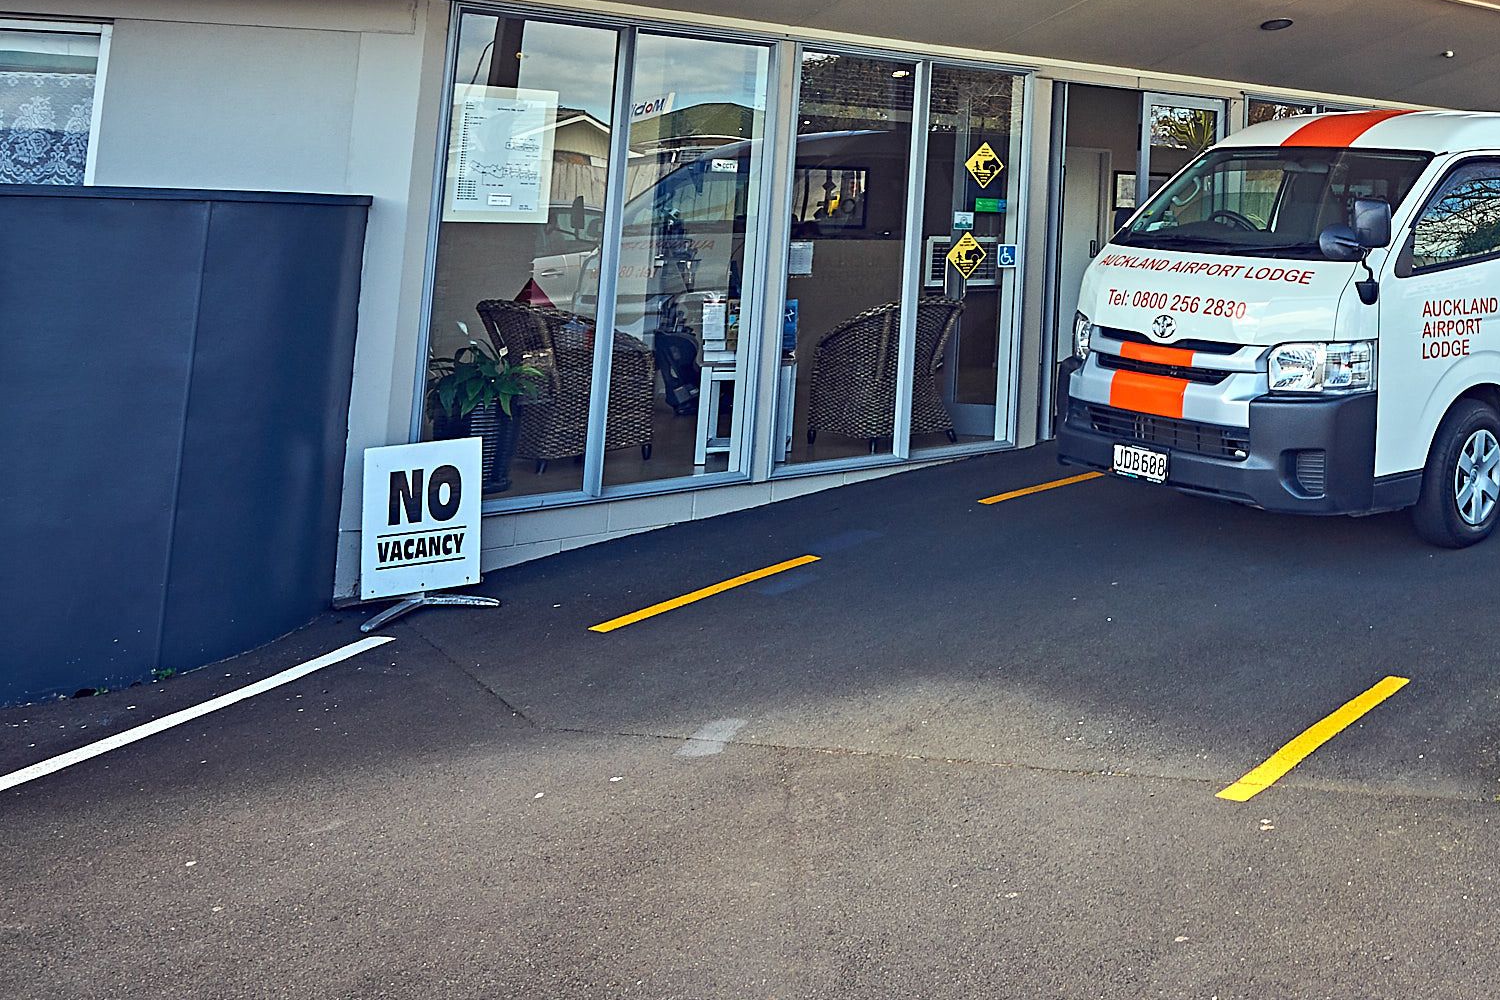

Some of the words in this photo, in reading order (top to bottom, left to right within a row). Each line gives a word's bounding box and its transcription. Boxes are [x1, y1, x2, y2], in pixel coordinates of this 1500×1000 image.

[1099, 254, 1170, 271] AUCKLAND
[1168, 260, 1245, 279] AIRPORT
[1244, 266, 1315, 285] LODGE
[1108, 288, 1130, 307] Tel:
[1132, 290, 1168, 310] 0800
[1170, 294, 1201, 313] 256
[1203, 298, 1247, 320] 2830
[1422, 297, 1498, 318] AUCKLAND
[1422, 318, 1482, 339] AIRPORT
[1422, 339, 1470, 360] LODGE
[1115, 448, 1165, 477] JDB608
[388, 464, 462, 526] NO
[377, 533, 465, 564] VACANCY
